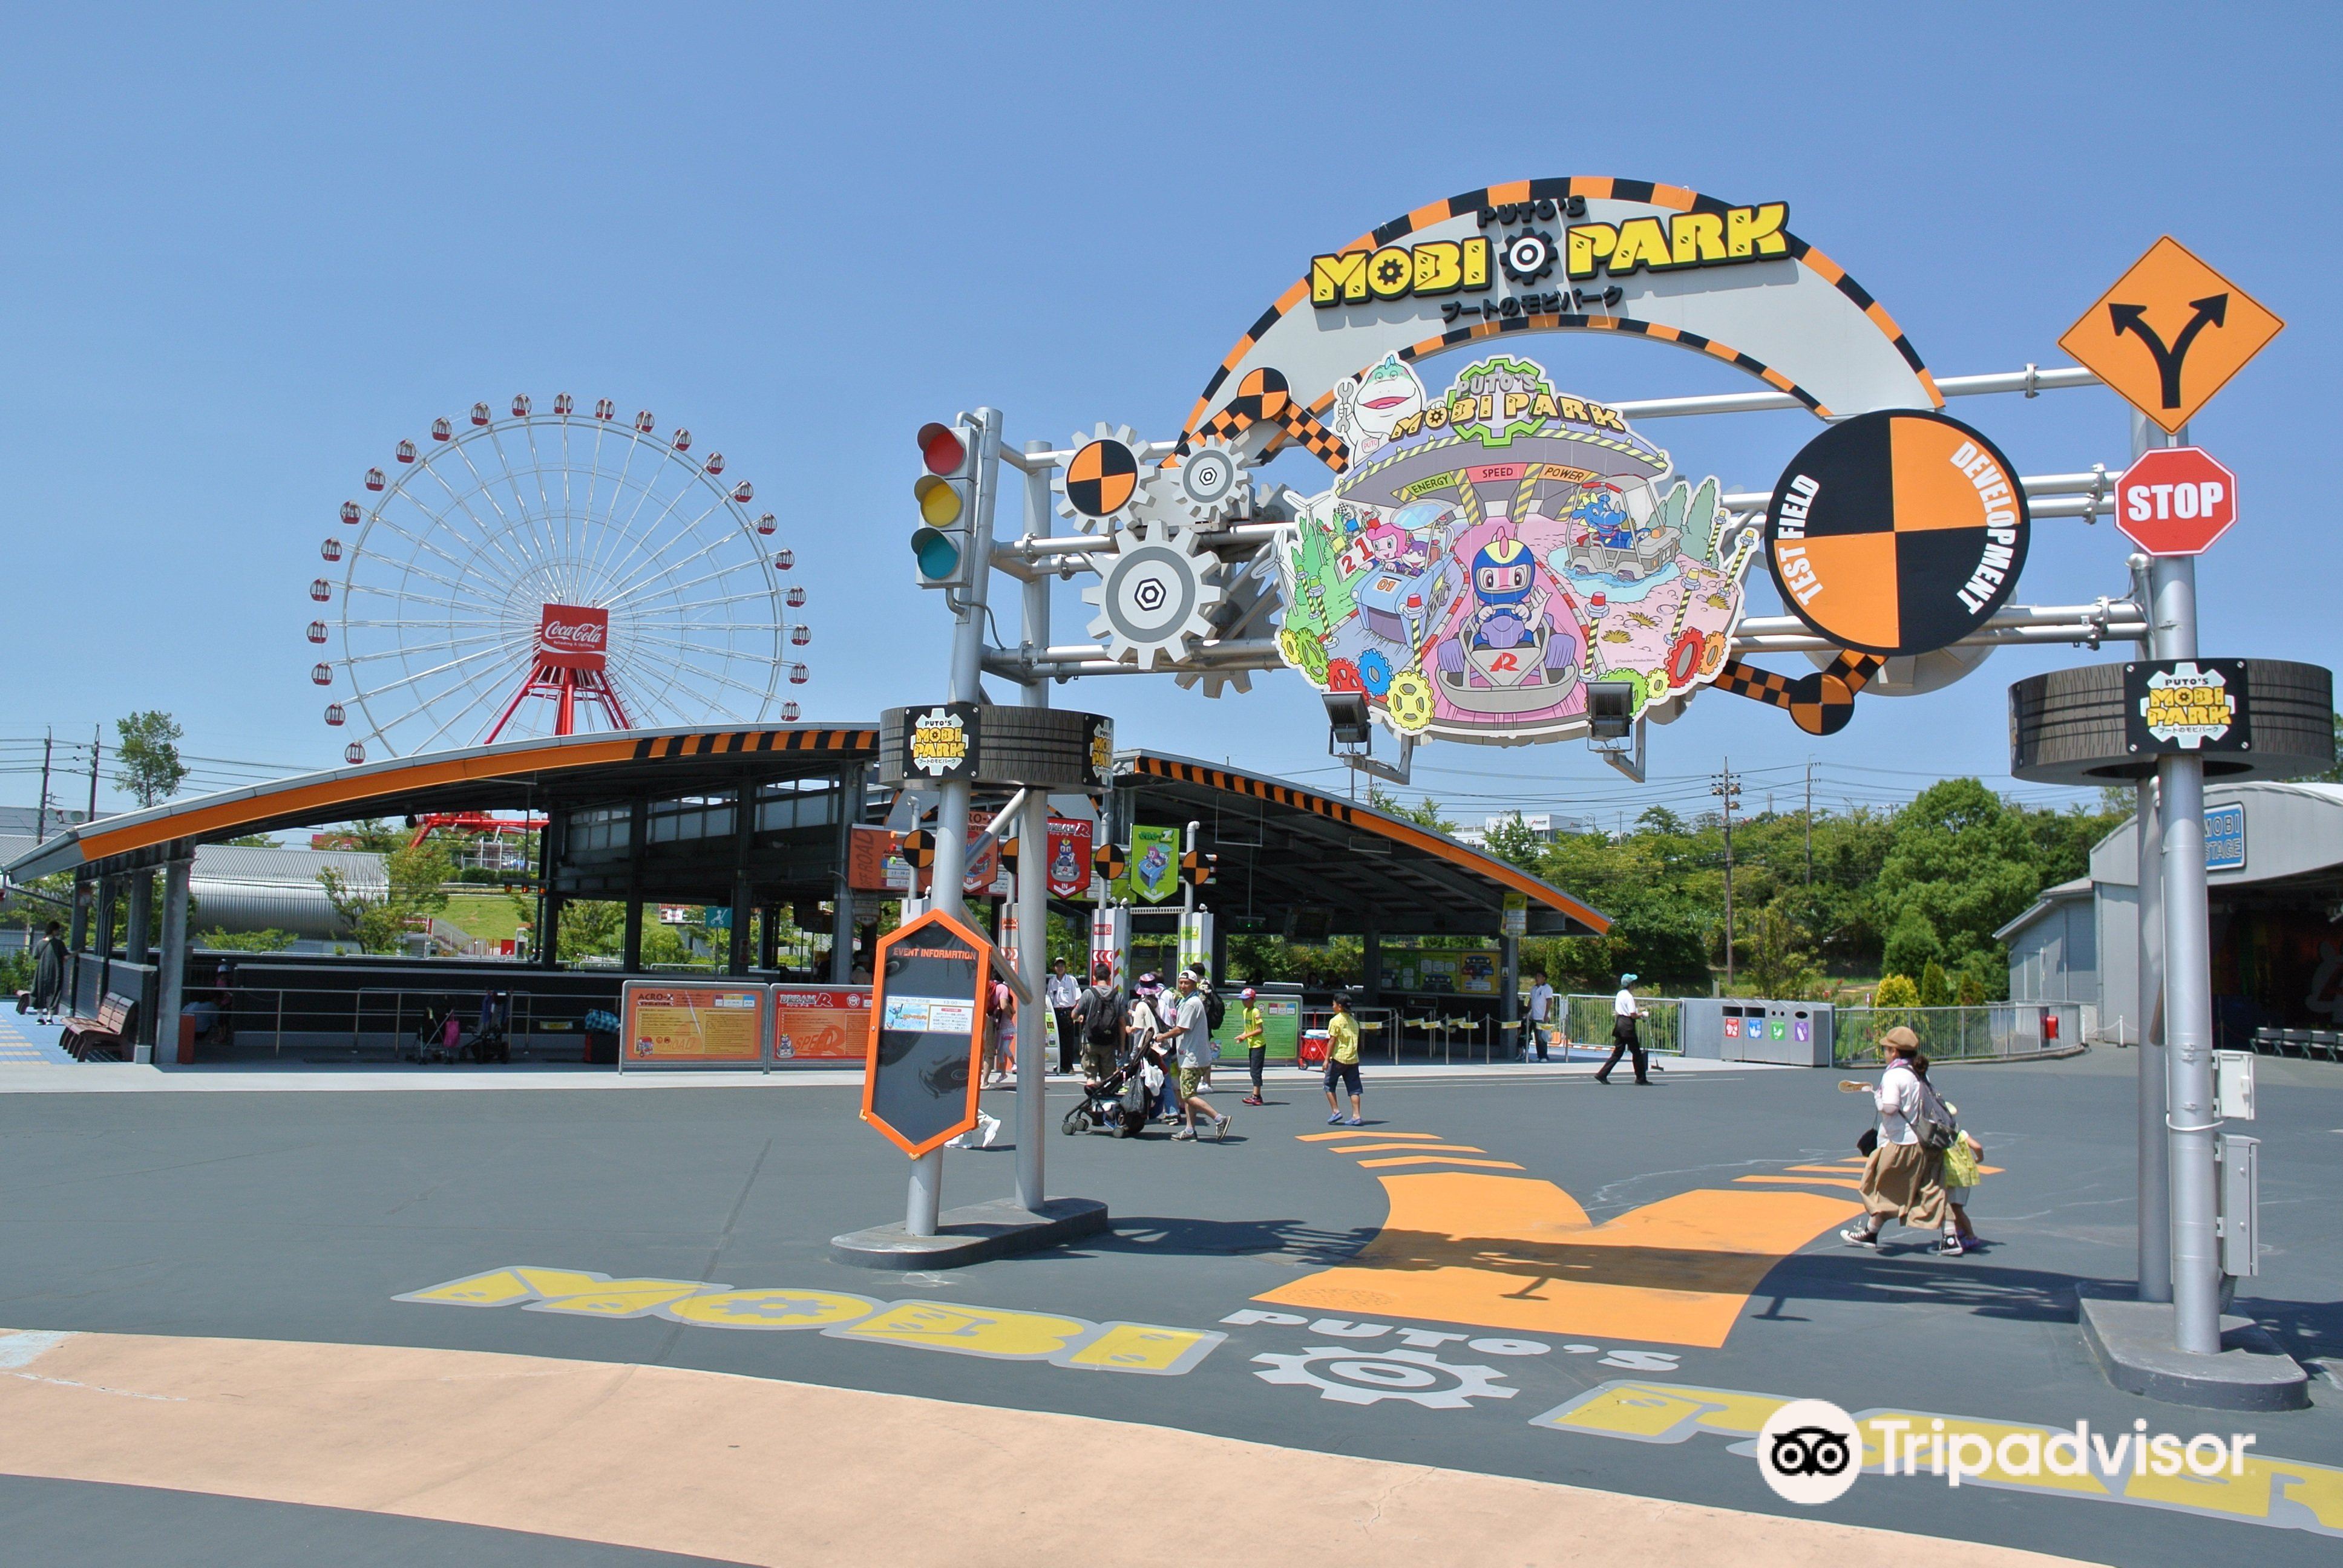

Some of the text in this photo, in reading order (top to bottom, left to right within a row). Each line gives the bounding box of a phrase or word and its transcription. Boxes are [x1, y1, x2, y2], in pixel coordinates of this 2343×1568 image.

[1477, 195, 1587, 229] PUTO'S
[1311, 202, 1791, 308] MOBI PARK
[1455, 373, 1538, 400] PUTO'S
[1389, 392, 1627, 442] MOBI PARK
[1364, 439, 1379, 449] PUTO
[1411, 475, 1449, 494] ENERGY
[1483, 467, 1513, 479] SPEED
[1544, 466, 1585, 482] POWER
[2127, 481, 2224, 521] STOP
[1950, 440, 2017, 615] DEVELOPMENT
[1778, 474, 1824, 606] TEST FIELD
[1377, 578, 1396, 592] 01
[2149, 687, 2225, 708] MOBI
[2146, 705, 2232, 727] PARK
[916, 727, 962, 743] MOBI
[913, 742, 966, 759] PARK
[853, 829, 874, 872] ROAD
[893, 947, 976, 960] EVENT INFORMATION
[390, 1265, 1228, 1375] MOBI
[1218, 1308, 1682, 1371] PUTO'S
